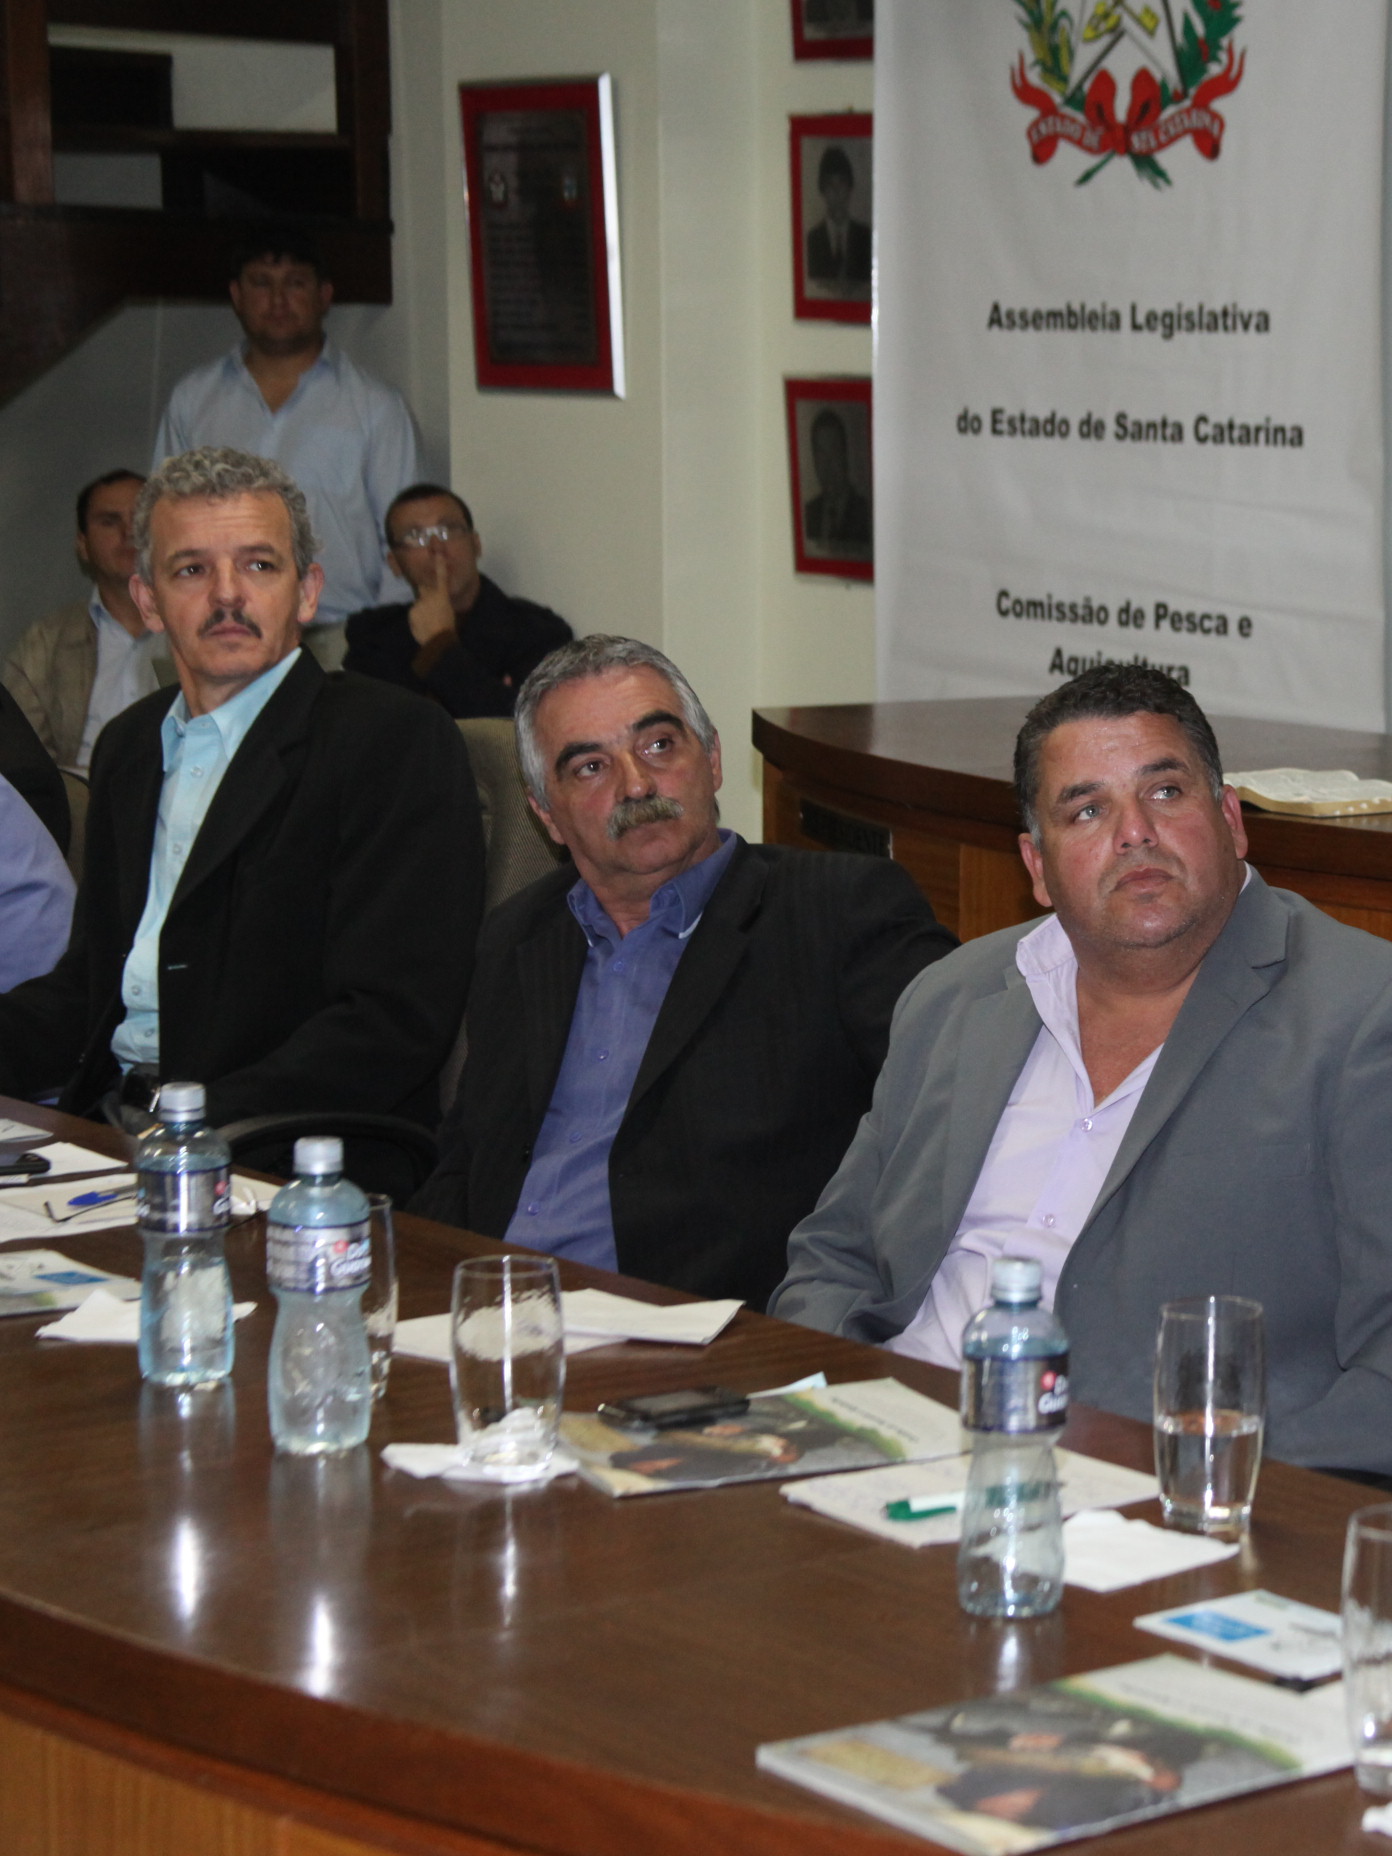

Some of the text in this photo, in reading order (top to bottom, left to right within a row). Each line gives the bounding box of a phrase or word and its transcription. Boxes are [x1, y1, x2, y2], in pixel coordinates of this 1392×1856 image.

[986, 301, 1271, 340] Assembleia Legislativa
[956, 407, 1304, 449] do Estado de Santa Catarina
[996, 589, 1253, 638] Comissão de Pesca e
